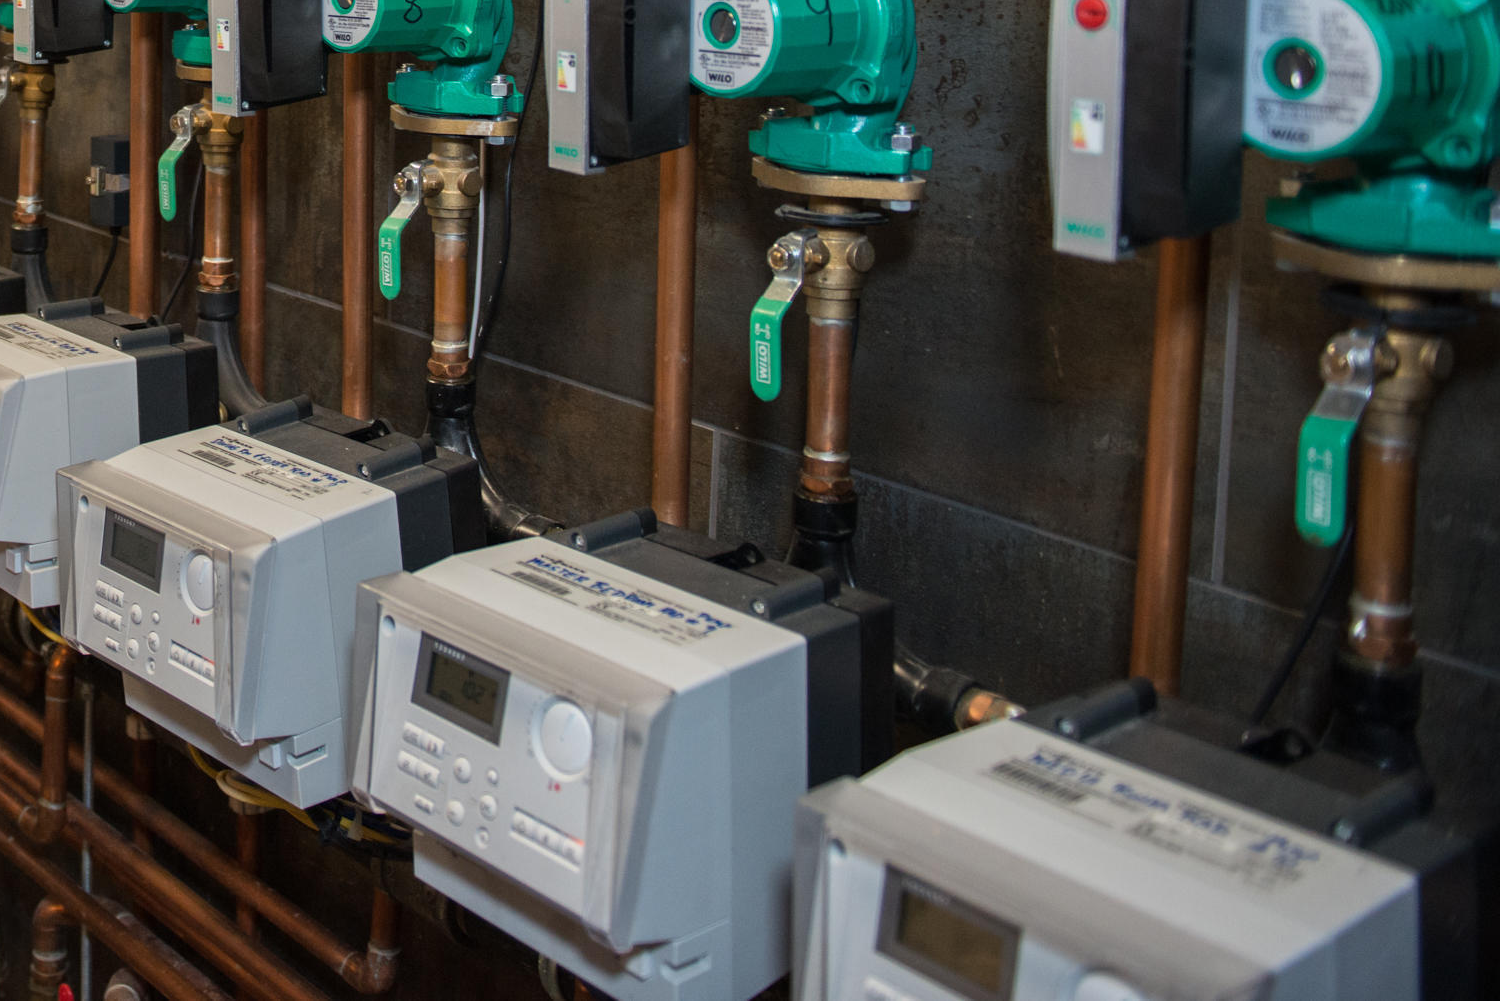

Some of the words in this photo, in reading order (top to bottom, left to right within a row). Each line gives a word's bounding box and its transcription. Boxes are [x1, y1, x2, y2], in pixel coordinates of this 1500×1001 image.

[708, 73, 732, 83] WILO
[1404, 42, 1445, 103] 10
[555, 145, 579, 157] WILO
[1066, 222, 1105, 239] WILO
[758, 345, 767, 379] WILO
[527, 556, 591, 583] MASTER
